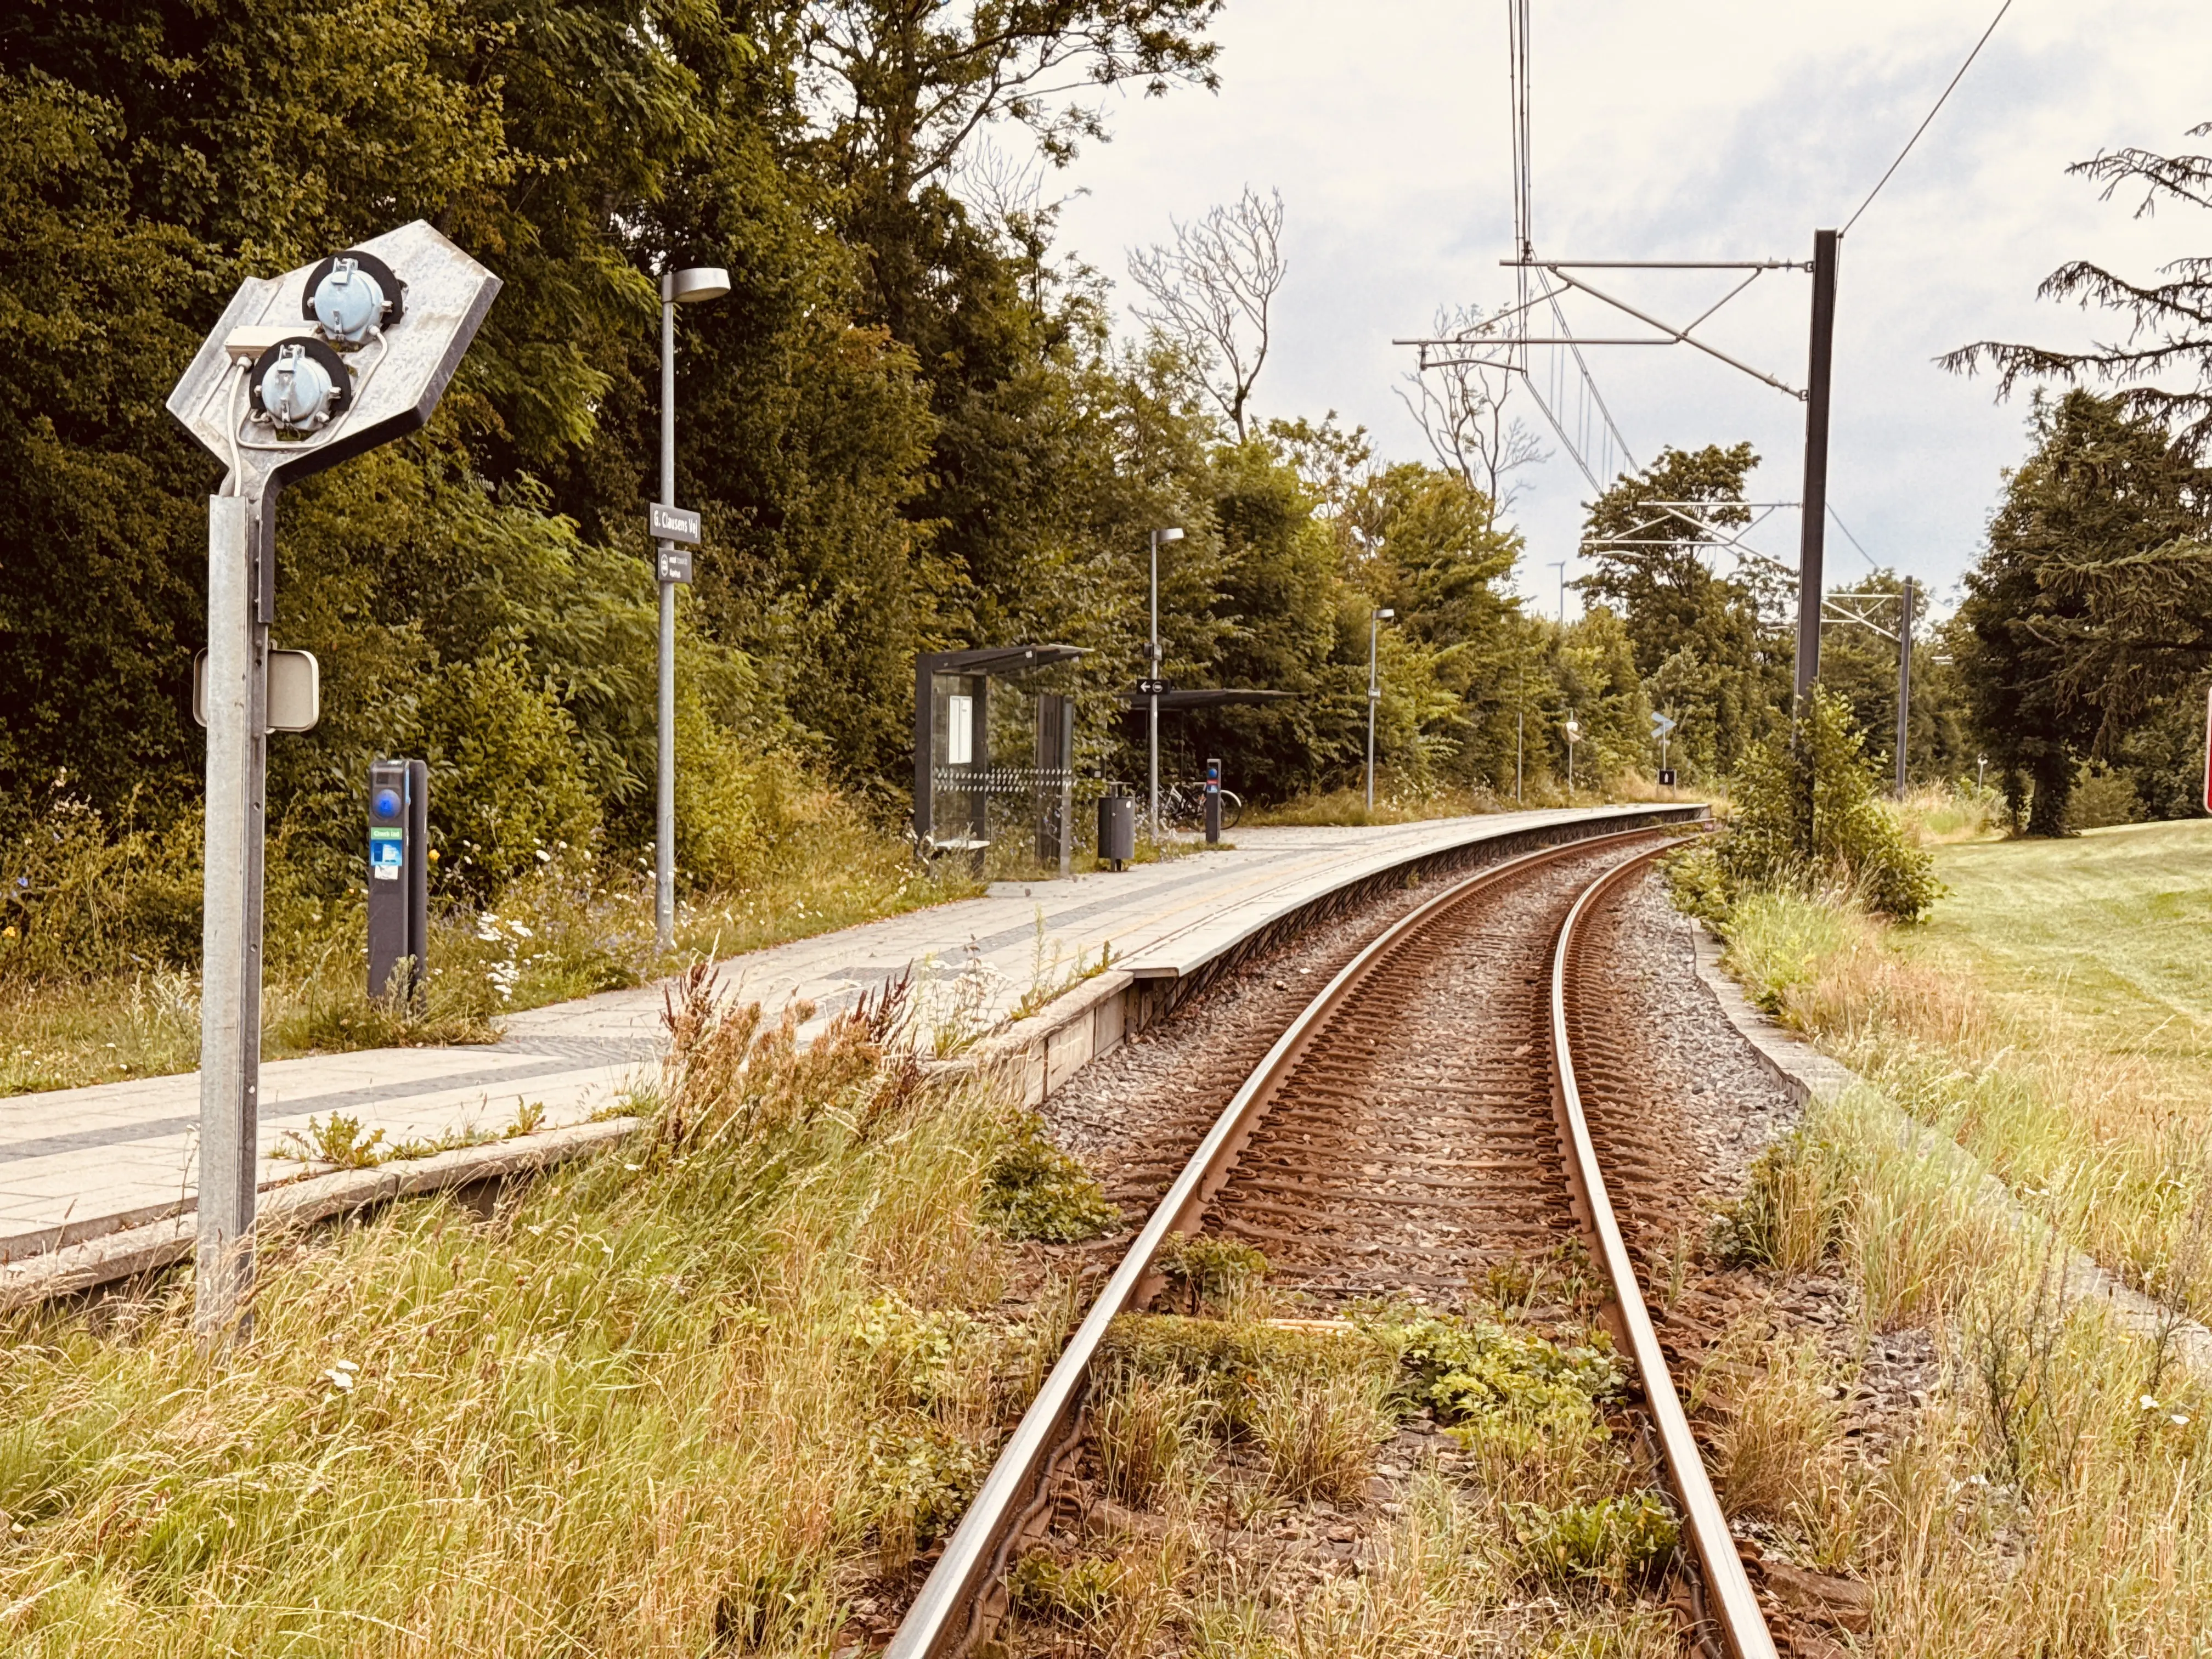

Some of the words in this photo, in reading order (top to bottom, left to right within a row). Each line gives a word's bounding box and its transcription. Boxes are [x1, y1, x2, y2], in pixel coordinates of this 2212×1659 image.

[654, 510, 661, 527] G.
[662, 511, 688, 533] Clausens
[689, 518, 698, 539] Vej
